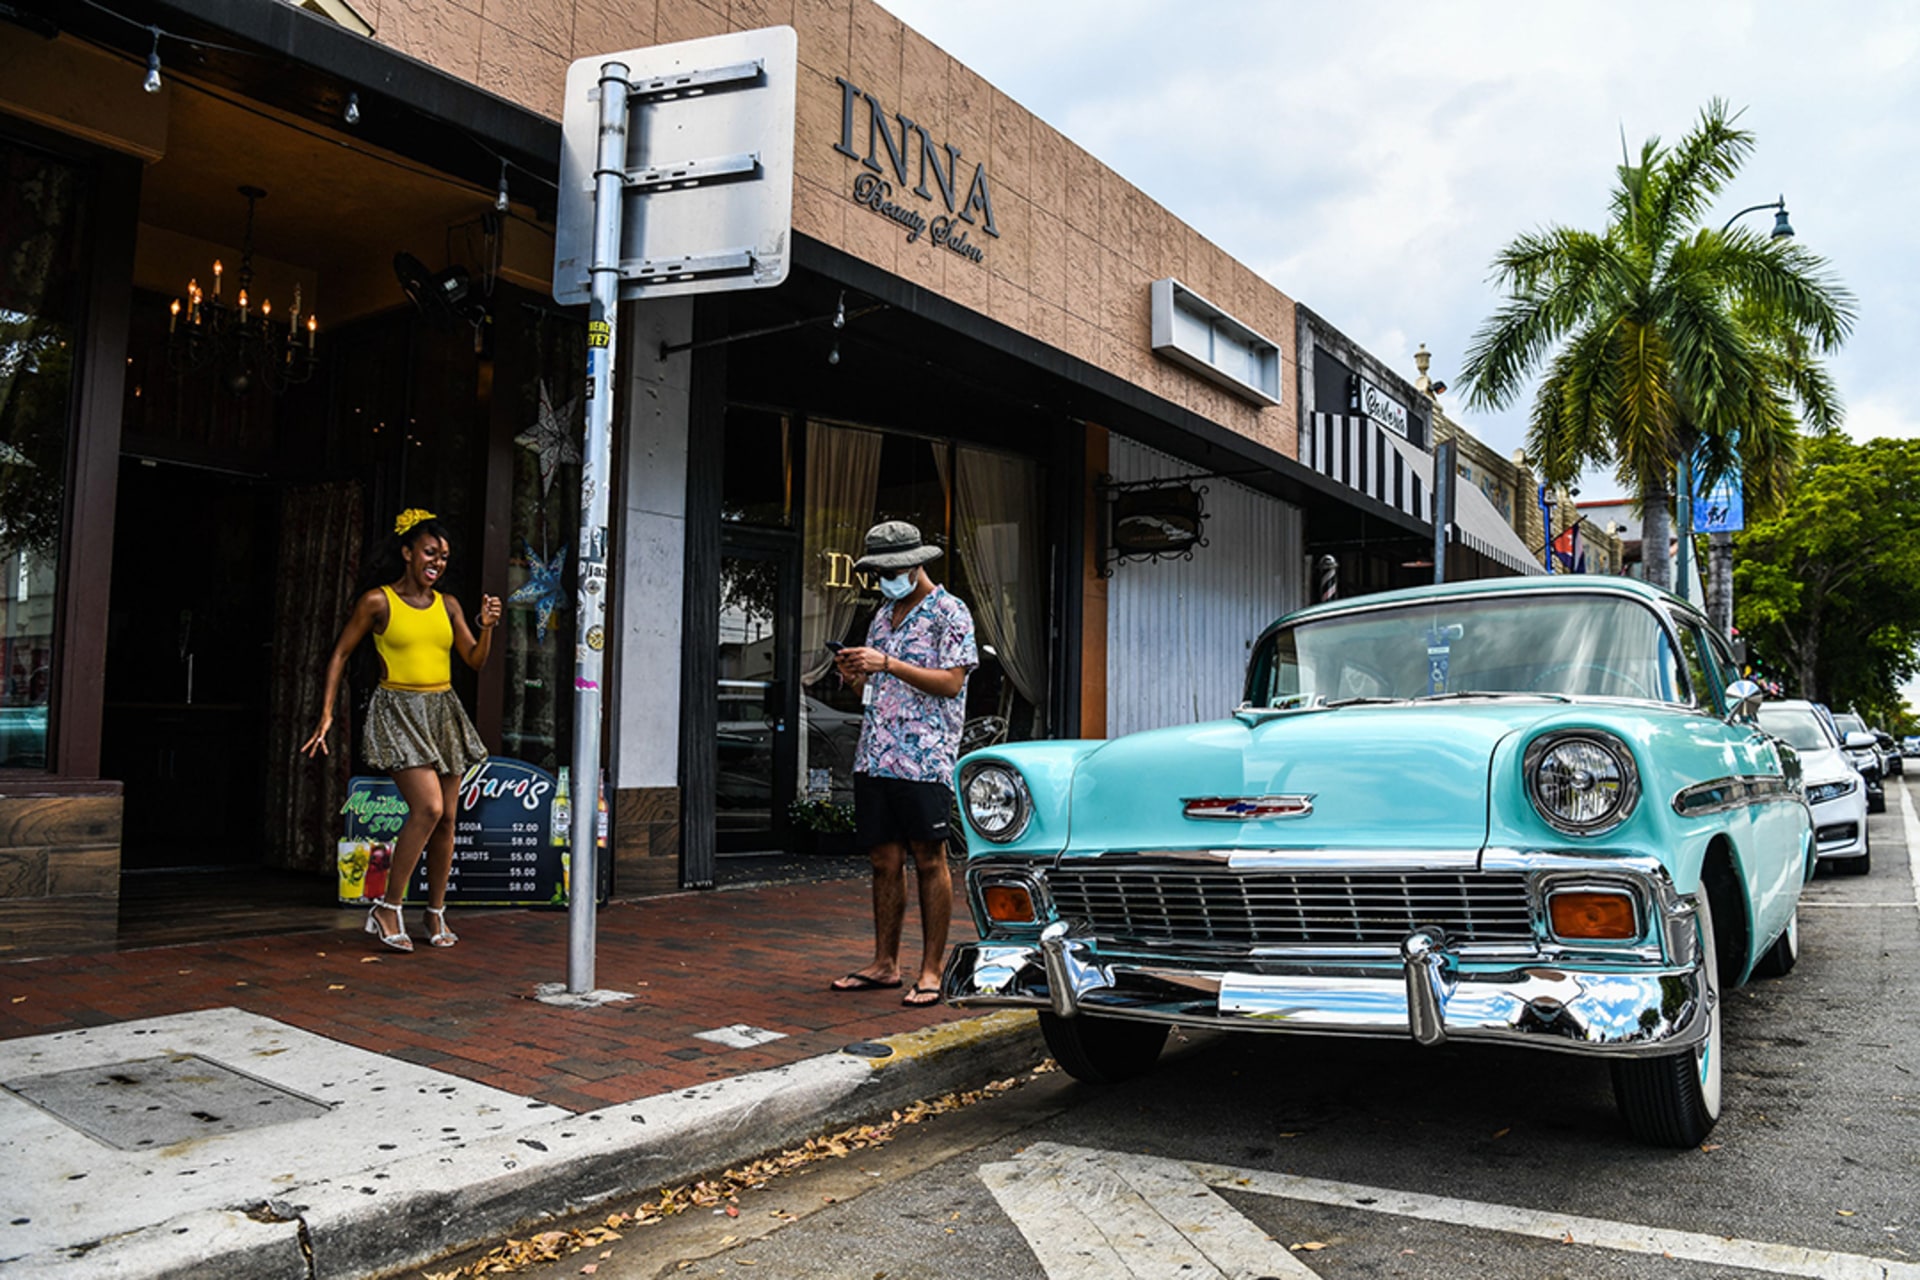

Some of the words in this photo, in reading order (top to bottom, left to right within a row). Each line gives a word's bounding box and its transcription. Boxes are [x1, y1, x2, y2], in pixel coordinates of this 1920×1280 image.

[833, 76, 999, 238] INNA
[853, 172, 926, 244] Beauty
[930, 214, 984, 264] Salon
[459, 762, 550, 811] lfaro's
[458, 822, 482, 831] SODA
[512, 822, 539, 832] $2.00
[460, 851, 489, 861] SHOTS
